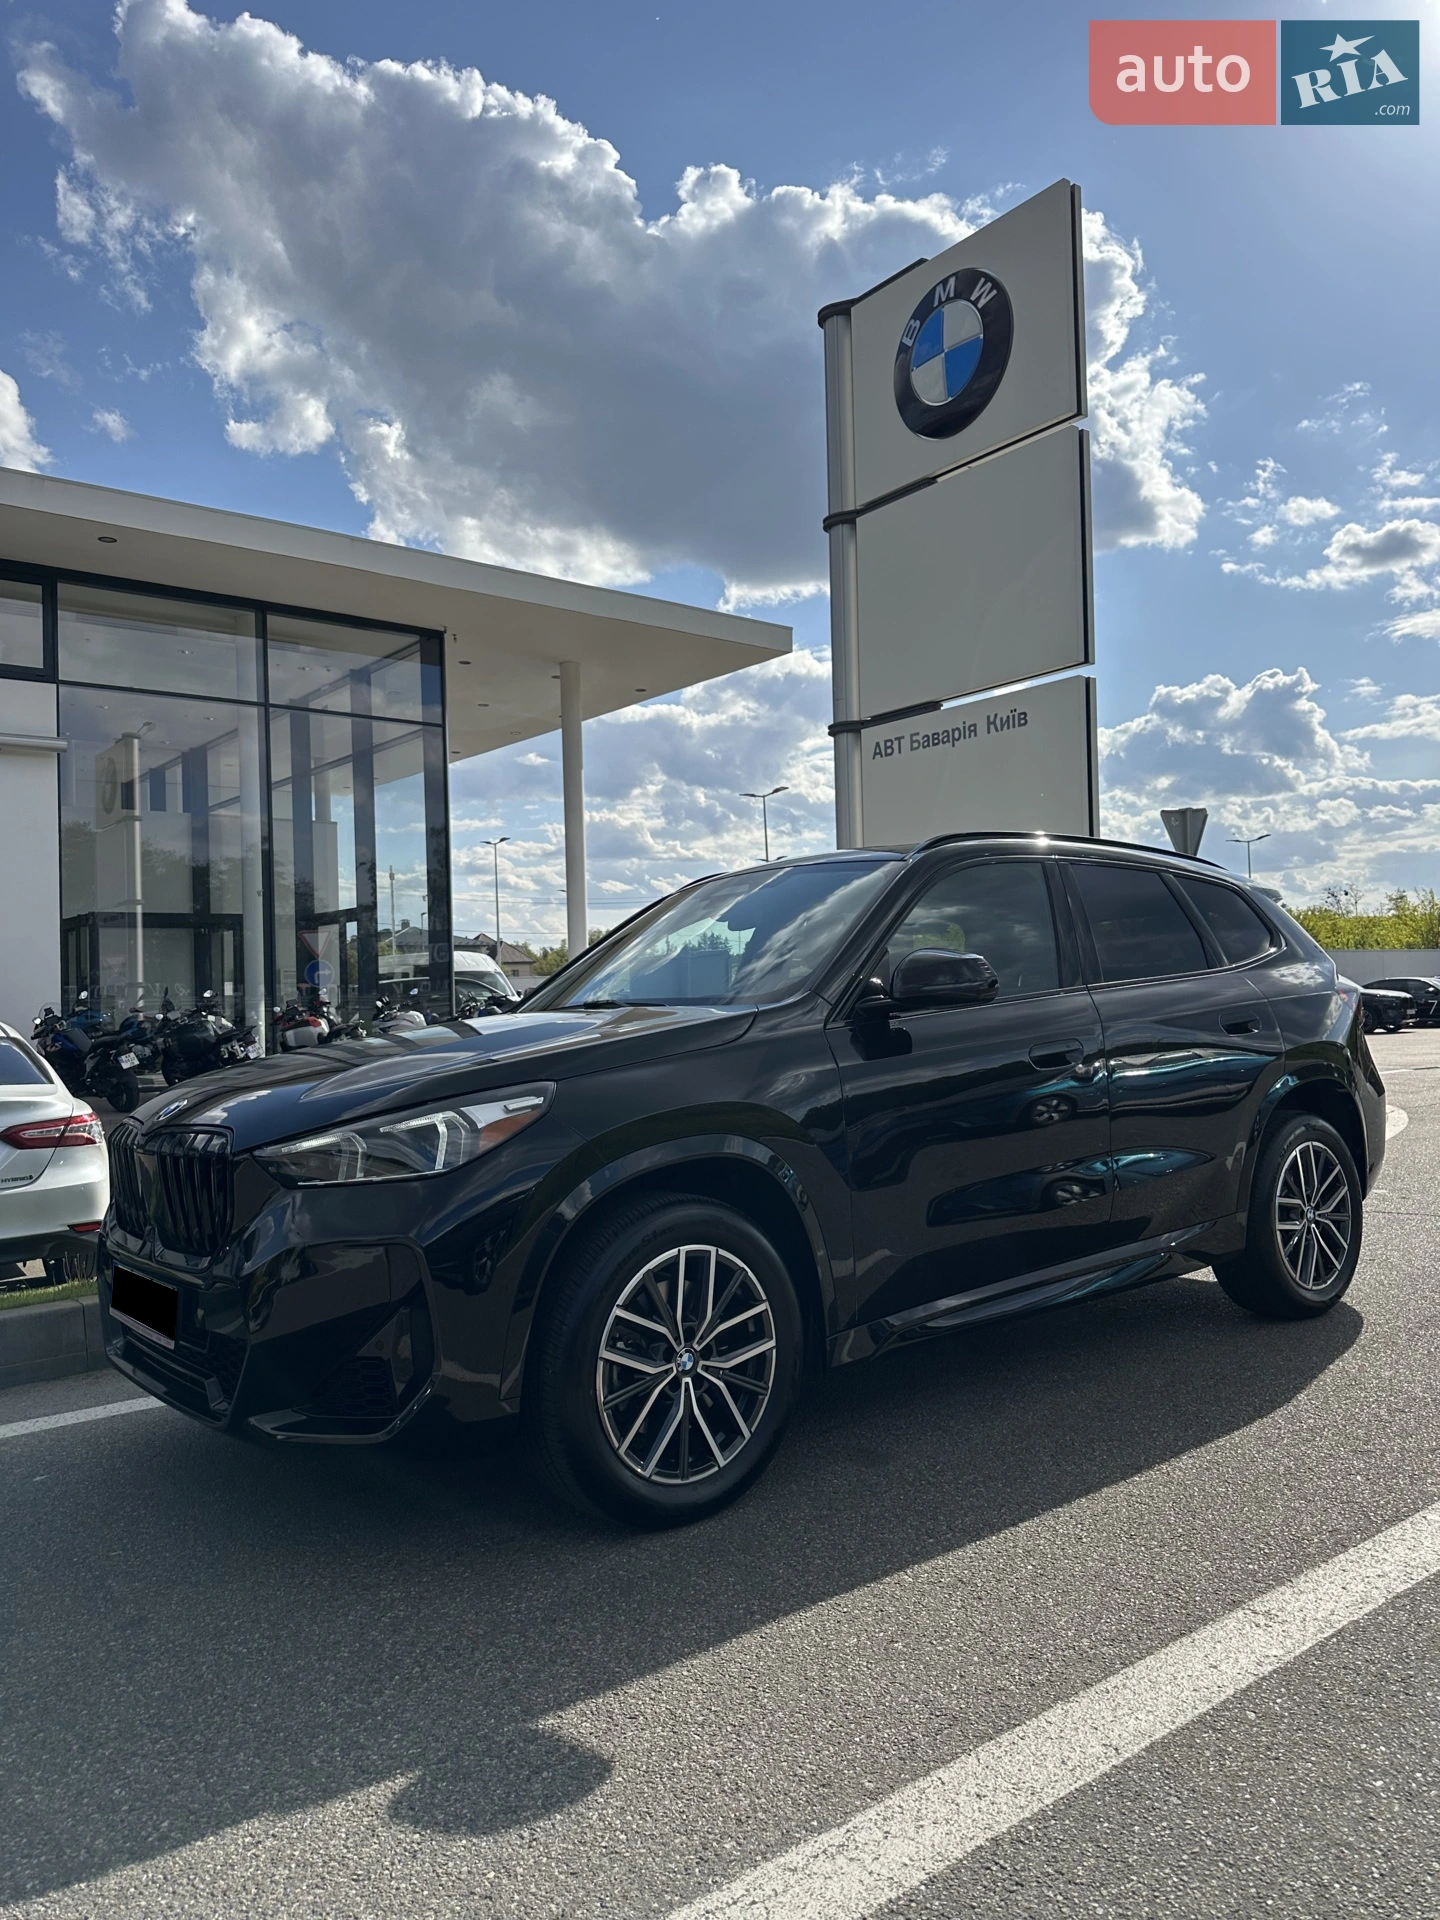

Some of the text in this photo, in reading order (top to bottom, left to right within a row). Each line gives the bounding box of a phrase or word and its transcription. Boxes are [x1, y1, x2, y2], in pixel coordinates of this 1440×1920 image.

[902, 276, 998, 347] BMW
[872, 708, 1028, 760] АВТ Баварія Київ
